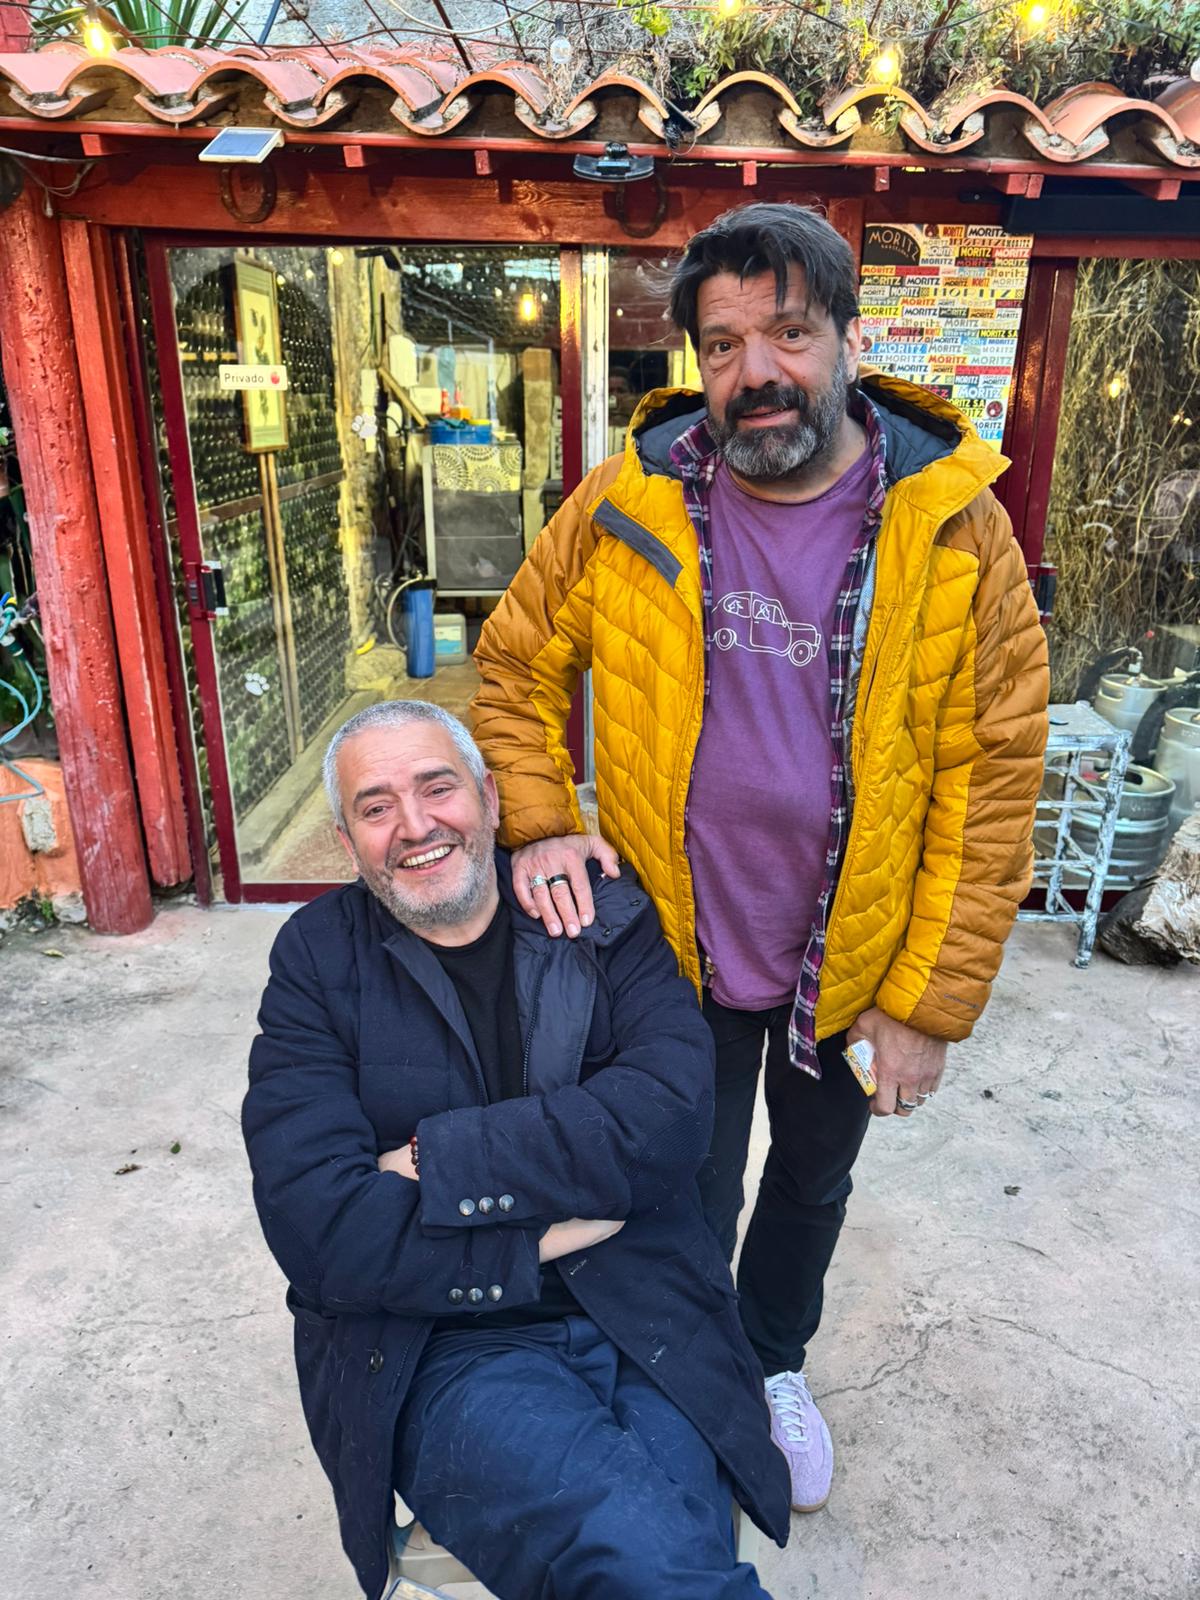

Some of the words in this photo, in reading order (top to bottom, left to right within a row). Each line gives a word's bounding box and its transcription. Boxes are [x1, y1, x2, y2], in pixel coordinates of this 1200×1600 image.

[968, 228, 1006, 237] MORITZ
[869, 230, 919, 262] MORITZ
[961, 247, 992, 257] MORITZ
[995, 249, 1029, 257] MORITZ
[864, 276, 901, 285] MORITZ
[907, 277, 940, 285] MORITZ
[891, 287, 919, 296] MORITZ
[861, 307, 899, 316] MORITZ
[905, 308, 938, 316] MORITZ
[860, 318, 896, 326] MORITZ
[944, 319, 979, 327] MORITZ
[880, 344, 922, 353] MORITZ
[928, 345, 960, 353] MORITZ
[928, 355, 967, 363] MORITZ
[971, 356, 1013, 364] MORITZ
[897, 365, 928, 373] MORITZ
[224, 372, 264, 383] Privado
[958, 387, 1000, 399] MORITZ
[952, 400, 970, 408] ORITZ
[962, 408, 983, 417] RITZ
